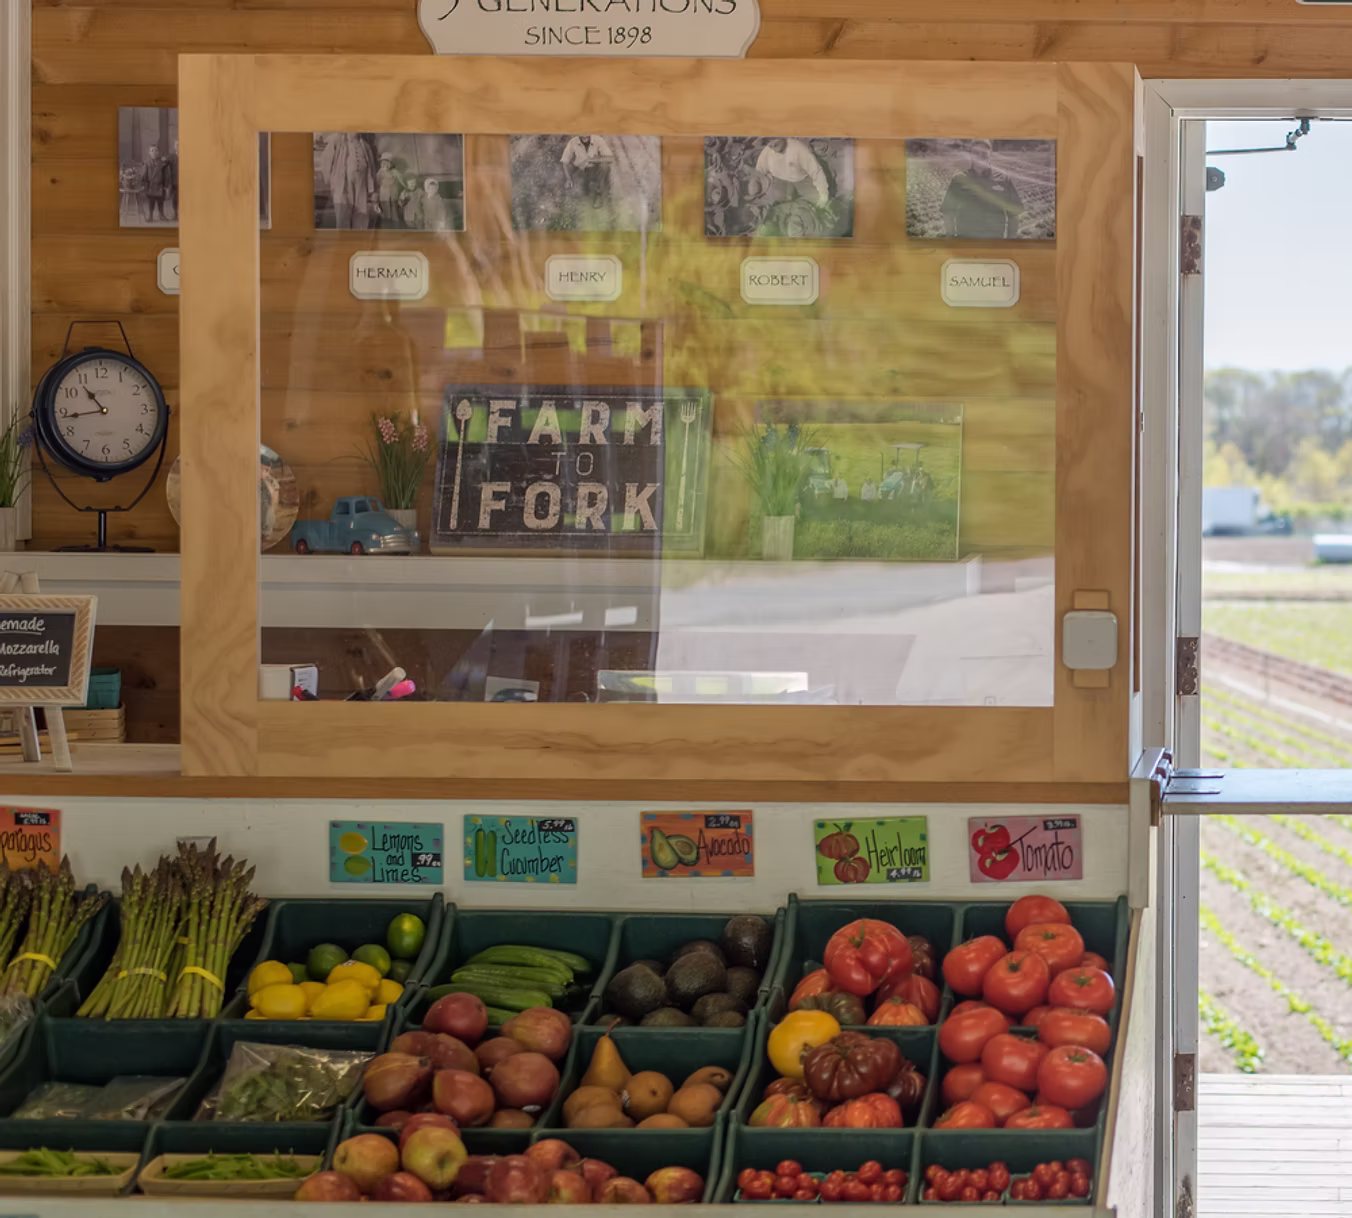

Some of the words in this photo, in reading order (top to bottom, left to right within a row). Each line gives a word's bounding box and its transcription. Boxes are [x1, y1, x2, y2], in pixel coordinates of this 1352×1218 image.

[525, 26, 601, 45] SINCE
[608, 26, 652, 48] 1898
[356, 267, 418, 279] HERMAN
[558, 271, 607, 283] HENRY
[749, 275, 809, 286] ROBERT
[949, 276, 1011, 287] SAMUEL
[79, 373, 88, 385] 11
[95, 367, 108, 379] 12
[118, 371, 123, 383] 1
[65, 387, 78, 399] 10
[132, 384, 141, 396] 2
[59, 407, 68, 418] 9
[140, 403, 149, 415] 3
[487, 399, 665, 445] FARM
[66, 425, 75, 437] 8
[135, 423, 144, 434] 4
[82, 439, 90, 450] 7
[101, 444, 111, 455] 6
[122, 438, 130, 450] 5
[551, 451, 594, 476] TO
[478, 481, 661, 530] FORK
[371, 825, 424, 852] Lemons
[502, 820, 569, 845] Seedless
[697, 827, 751, 865] Avocado
[865, 829, 926, 873] Heirloom
[1007, 826, 1074, 876] Tomato
[386, 852, 405, 867] and
[416, 854, 433, 866] .99
[501, 847, 565, 876] Cucumber
[371, 856, 423, 883] Limes
